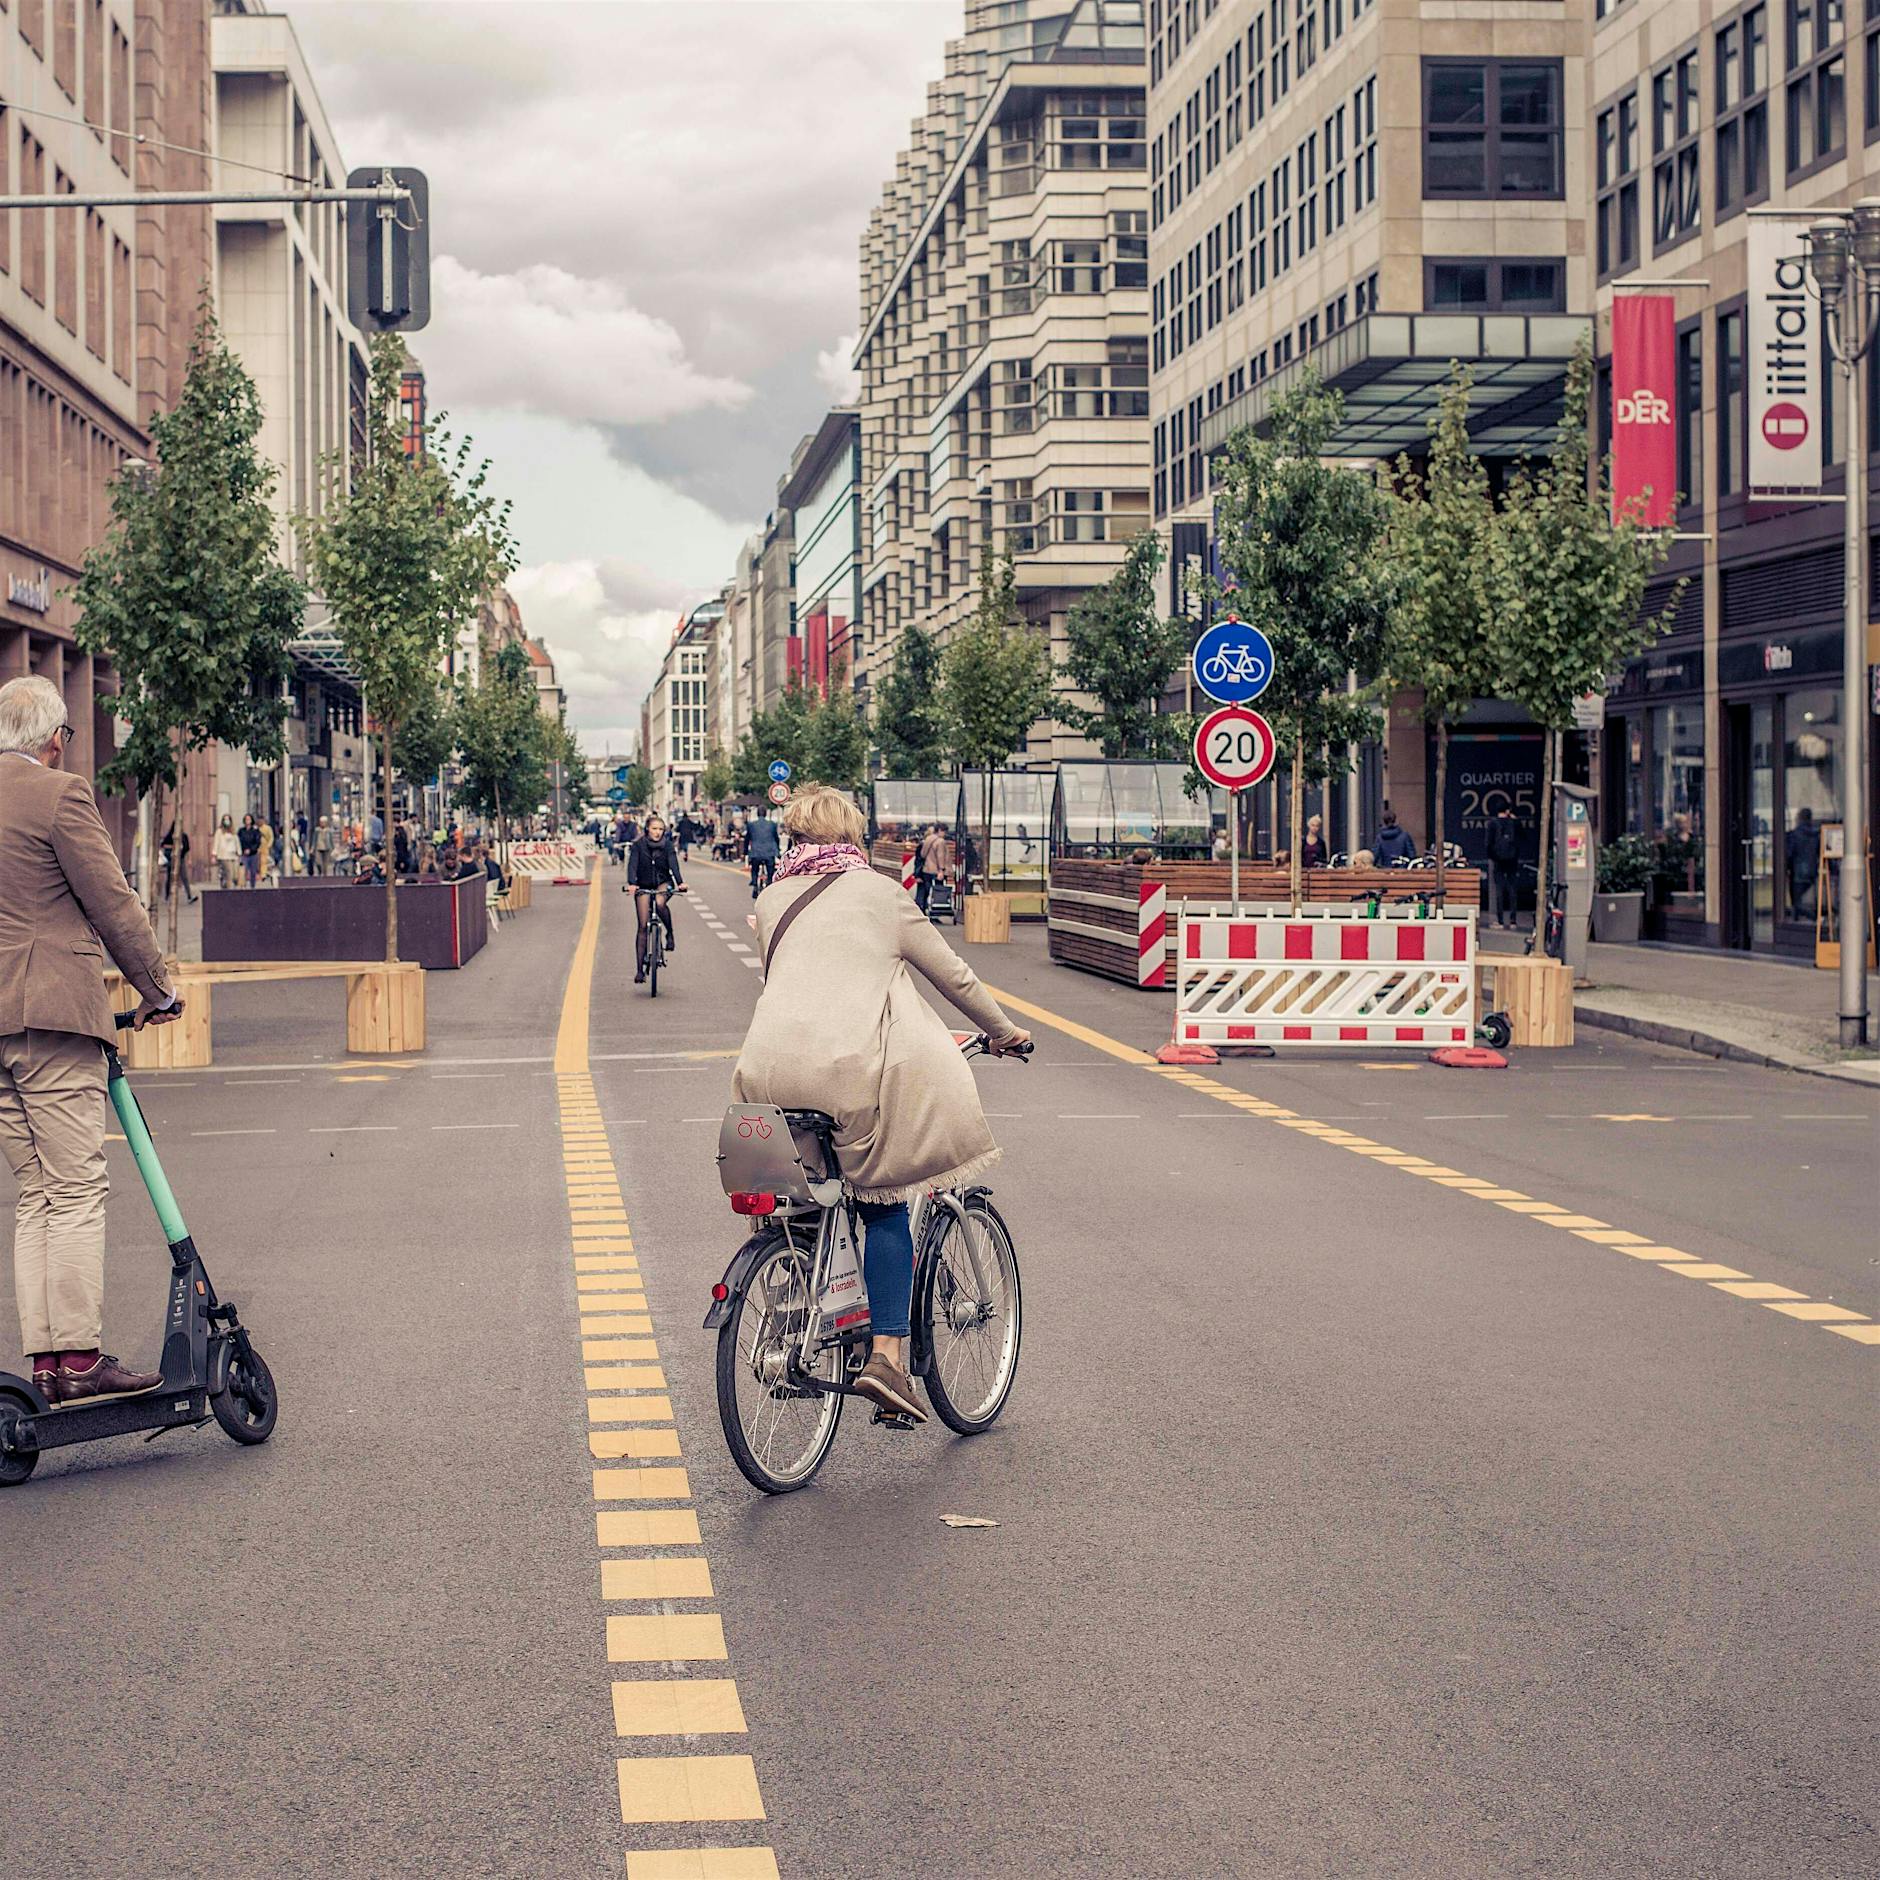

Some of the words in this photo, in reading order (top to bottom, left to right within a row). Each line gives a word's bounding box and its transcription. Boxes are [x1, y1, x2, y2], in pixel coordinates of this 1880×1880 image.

[1766, 259, 1806, 395] iittala
[1617, 397, 1671, 425] DER
[1214, 732, 1256, 764] 20
[1460, 772, 1535, 785] QUARTIER
[774, 788, 786, 798] 20
[1461, 789, 1536, 816] 205
[1572, 802, 1584, 820] P
